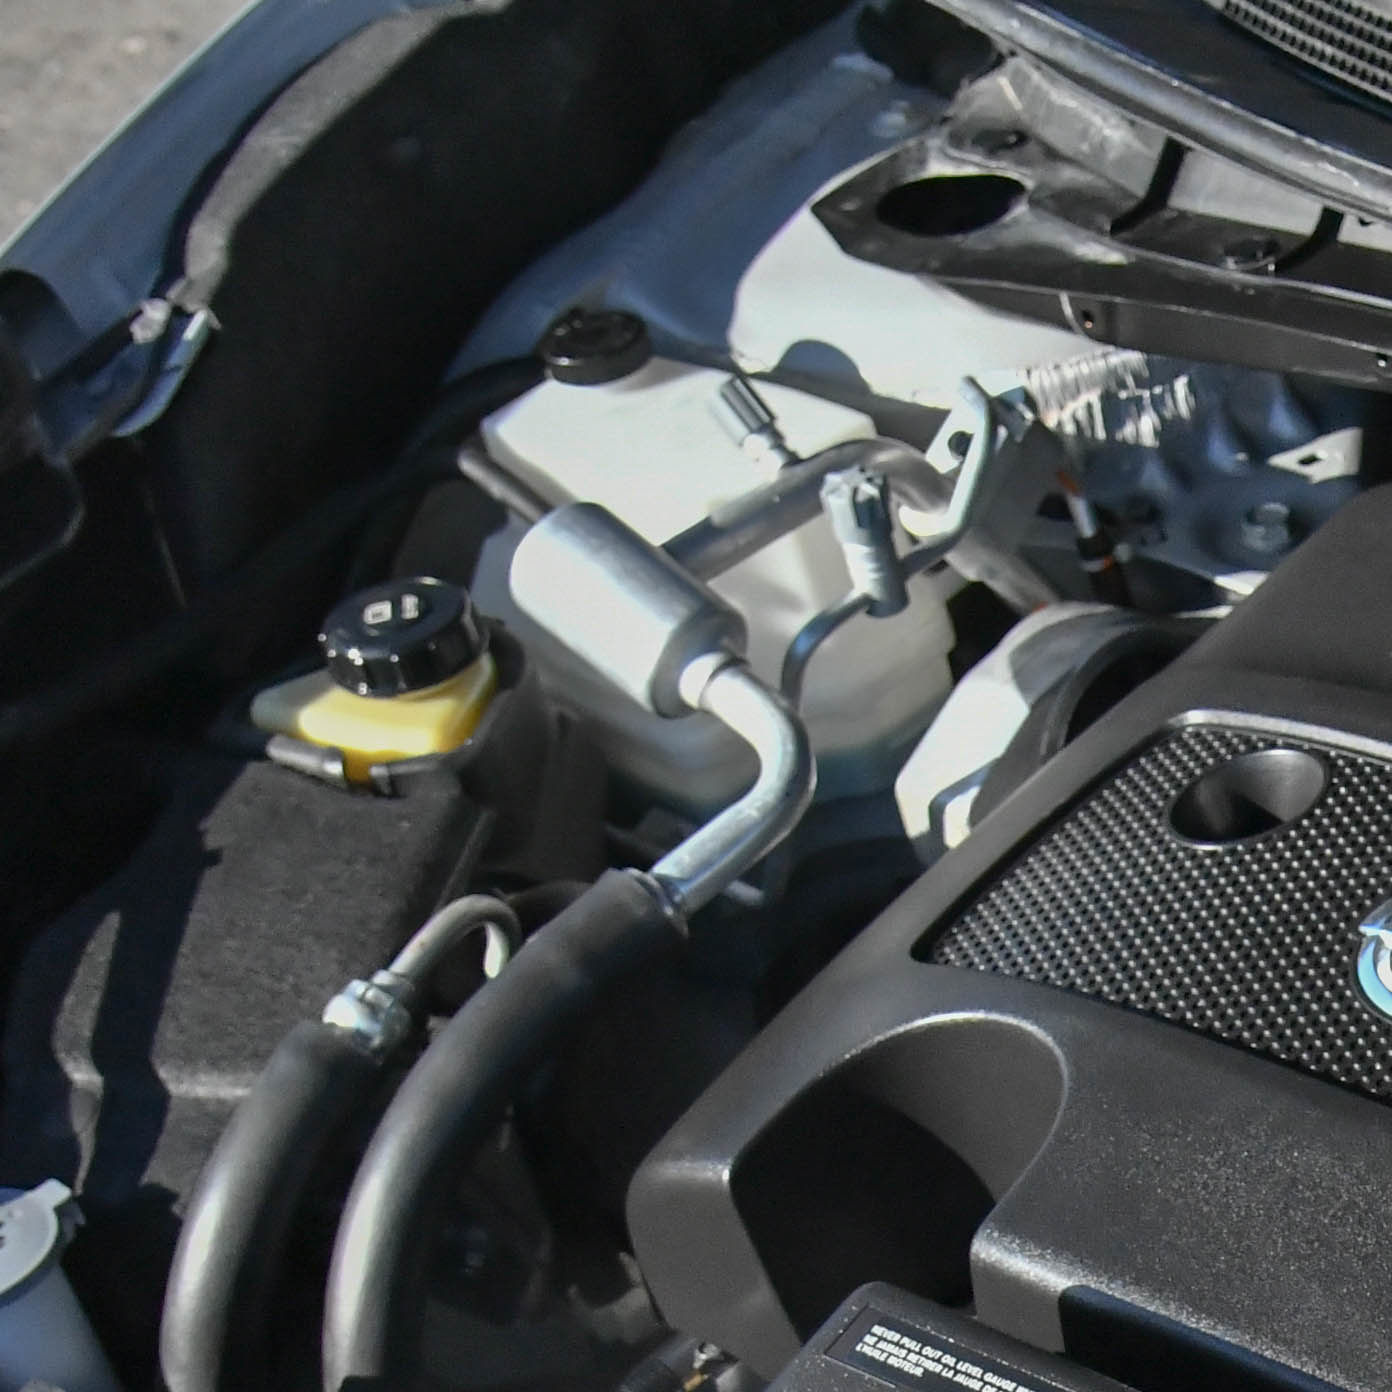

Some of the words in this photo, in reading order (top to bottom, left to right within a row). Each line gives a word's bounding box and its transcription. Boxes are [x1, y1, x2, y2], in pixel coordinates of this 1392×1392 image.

[855, 1342, 888, 1361] L'HUILE
[886, 1355, 923, 1376] MOTEUR.
[863, 1334, 878, 1345] NE
[875, 1340, 907, 1357] JAMAIS
[906, 1352, 942, 1372] RETIRER
[940, 1367, 954, 1378] LA
[952, 1373, 983, 1390] JAUGE
[871, 1324, 901, 1342] NEVER
[899, 1336, 921, 1352] PULL
[921, 1346, 943, 1359] OUT
[940, 1354, 956, 1366] OIL
[956, 1361, 983, 1378] LEVEL
[983, 1372, 1016, 1391] GAUGE
